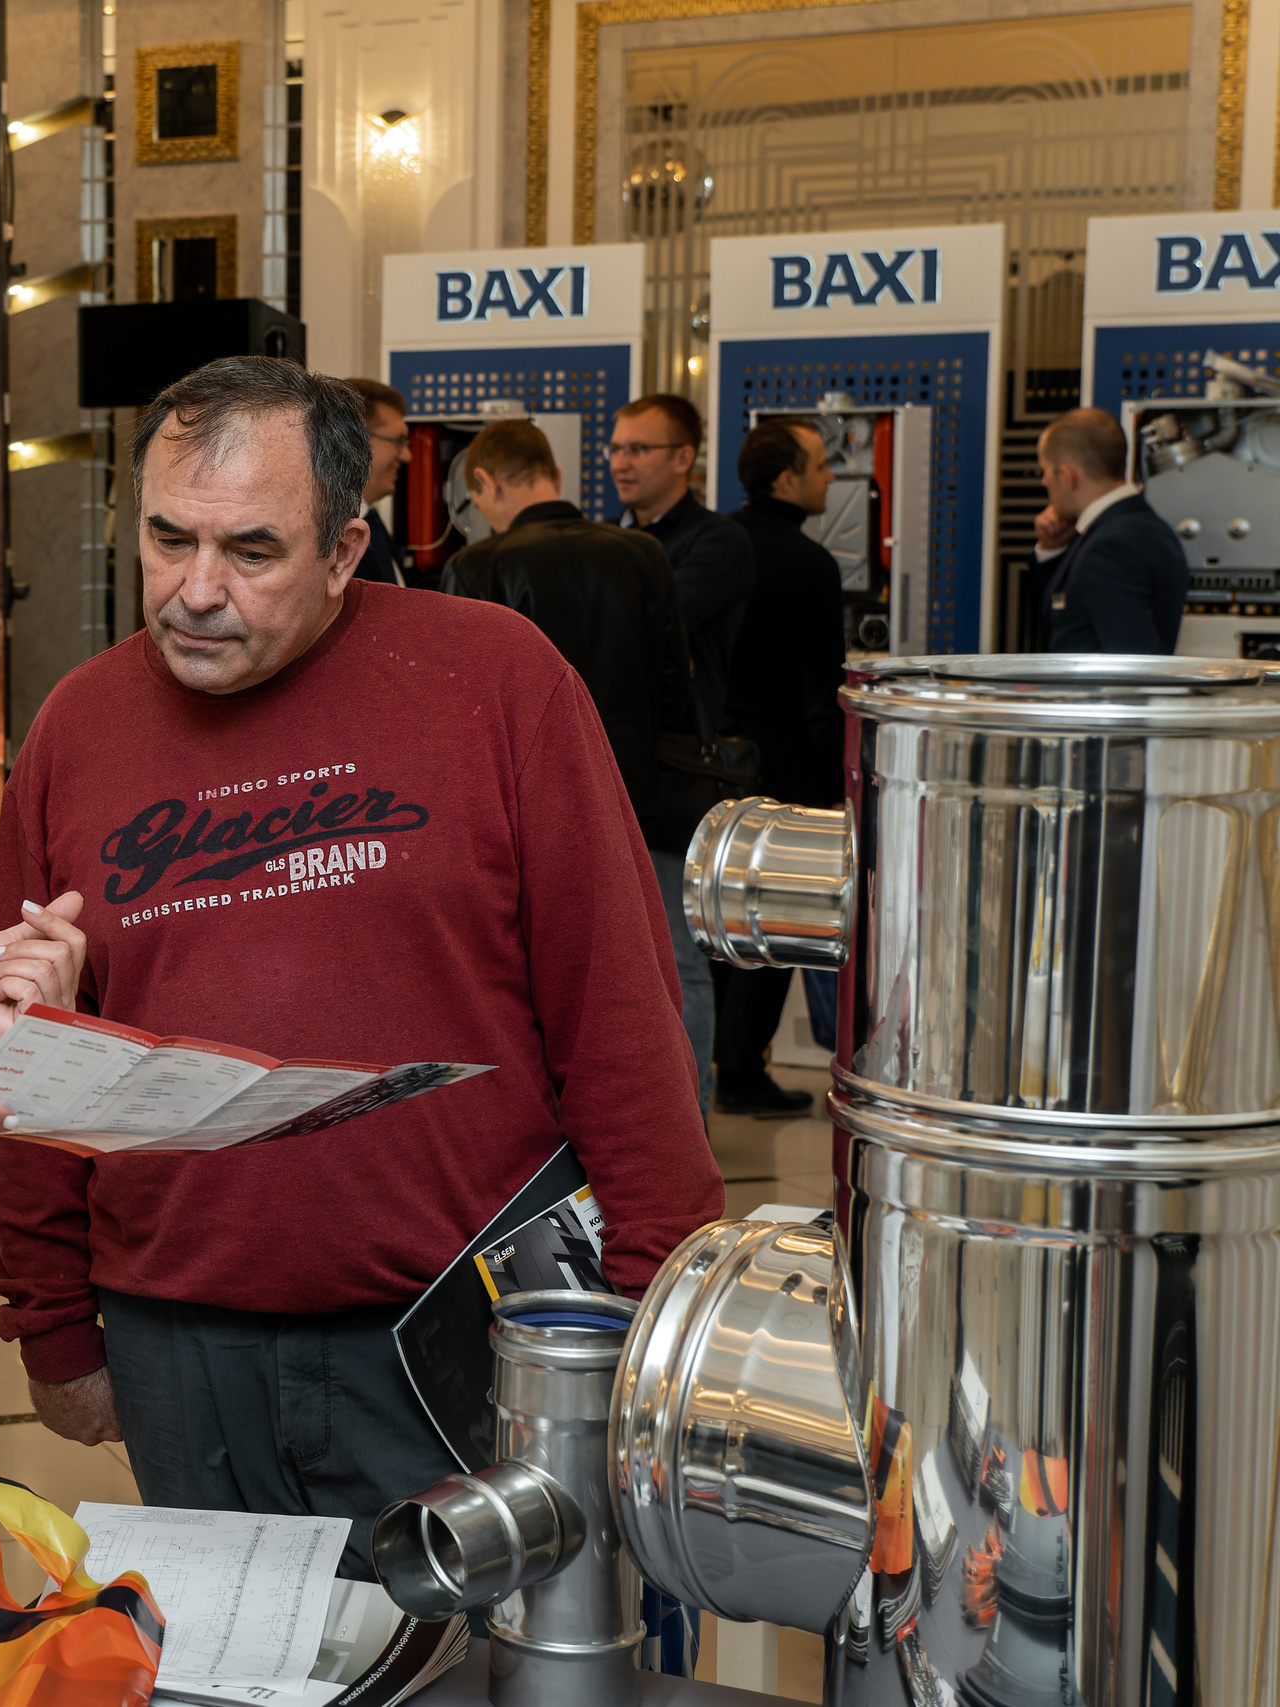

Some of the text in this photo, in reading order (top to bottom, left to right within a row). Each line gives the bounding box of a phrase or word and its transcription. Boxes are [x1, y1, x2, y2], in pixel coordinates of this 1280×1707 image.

[436, 264, 590, 322] BAXI
[770, 247, 943, 309] BAXI
[198, 762, 357, 802] INDIGO SPORTS
[100, 782, 430, 905] Glacier
[265, 840, 387, 882] GLS BRAND
[121, 872, 356, 928] REGISTERED TRADEMARK
[493, 1244, 516, 1263] ELSEN
[387, 1616, 418, 1666] екомендации
